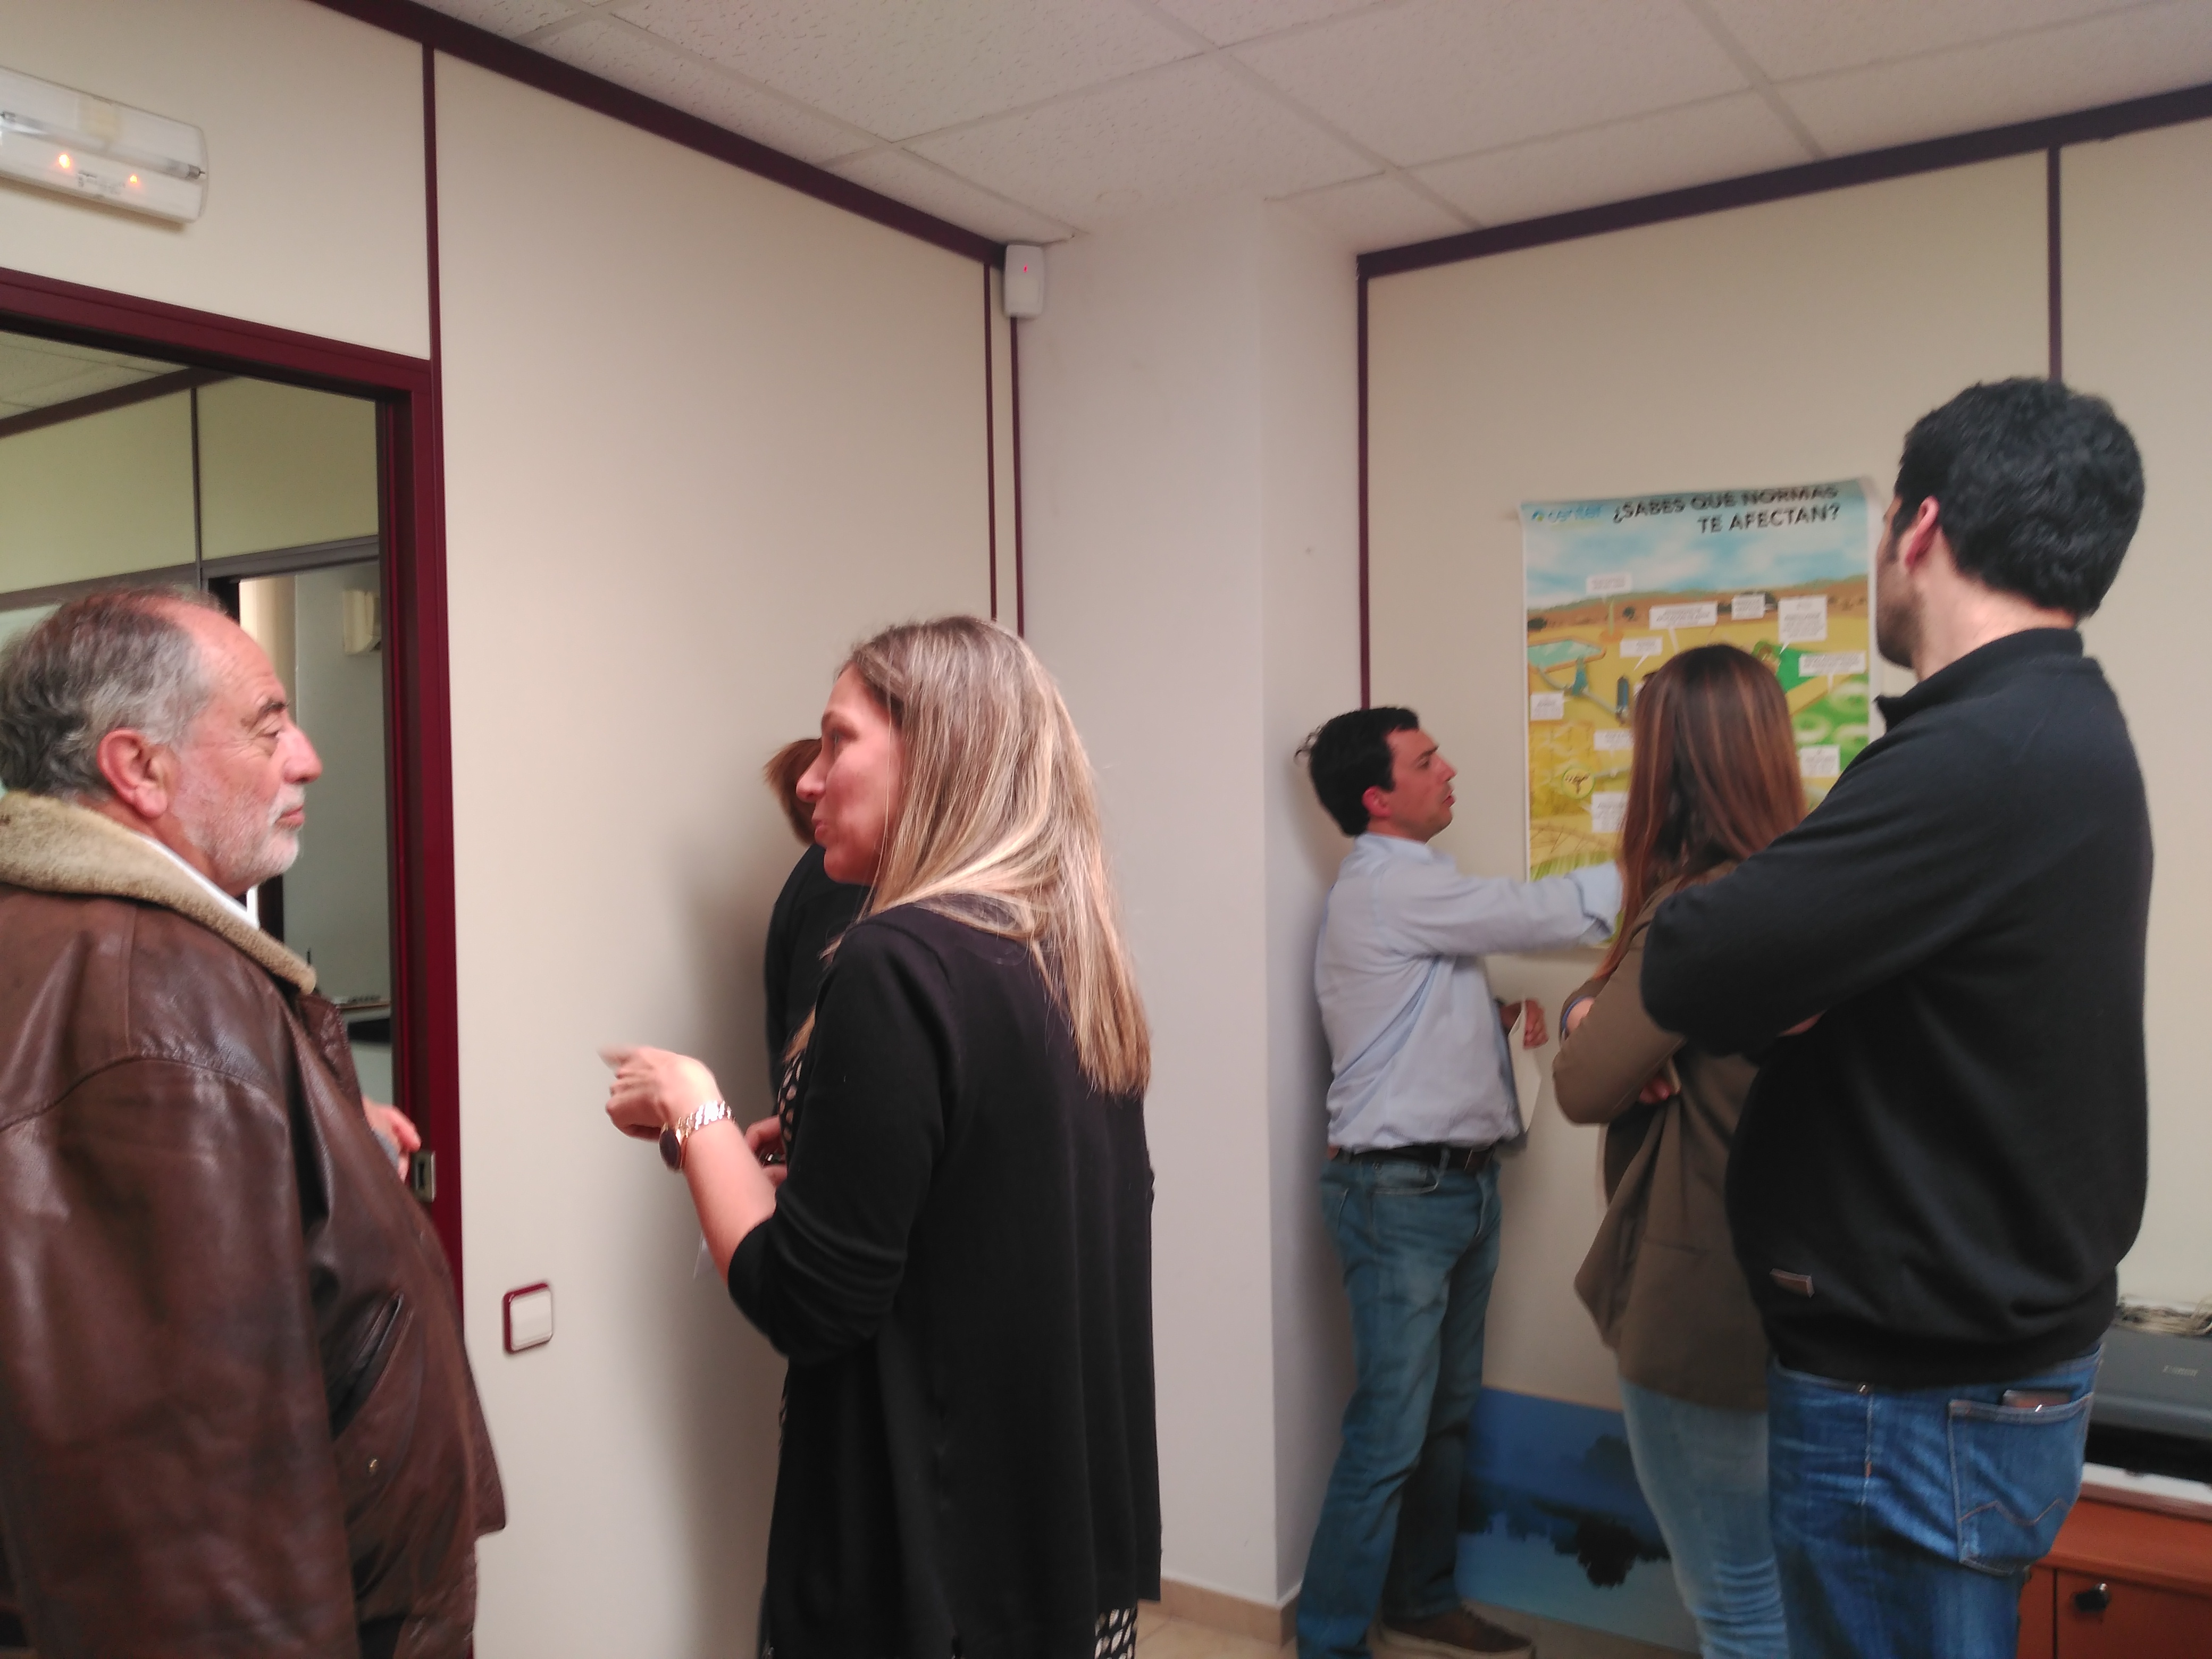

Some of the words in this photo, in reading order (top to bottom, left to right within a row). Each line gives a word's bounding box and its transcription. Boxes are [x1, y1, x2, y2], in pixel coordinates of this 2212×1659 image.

[1613, 498, 1686, 523] ¿SABES
[1741, 483, 1839, 506] NORMAS
[1697, 513, 1723, 534] TE
[1728, 501, 1841, 531] AFECTAN?
